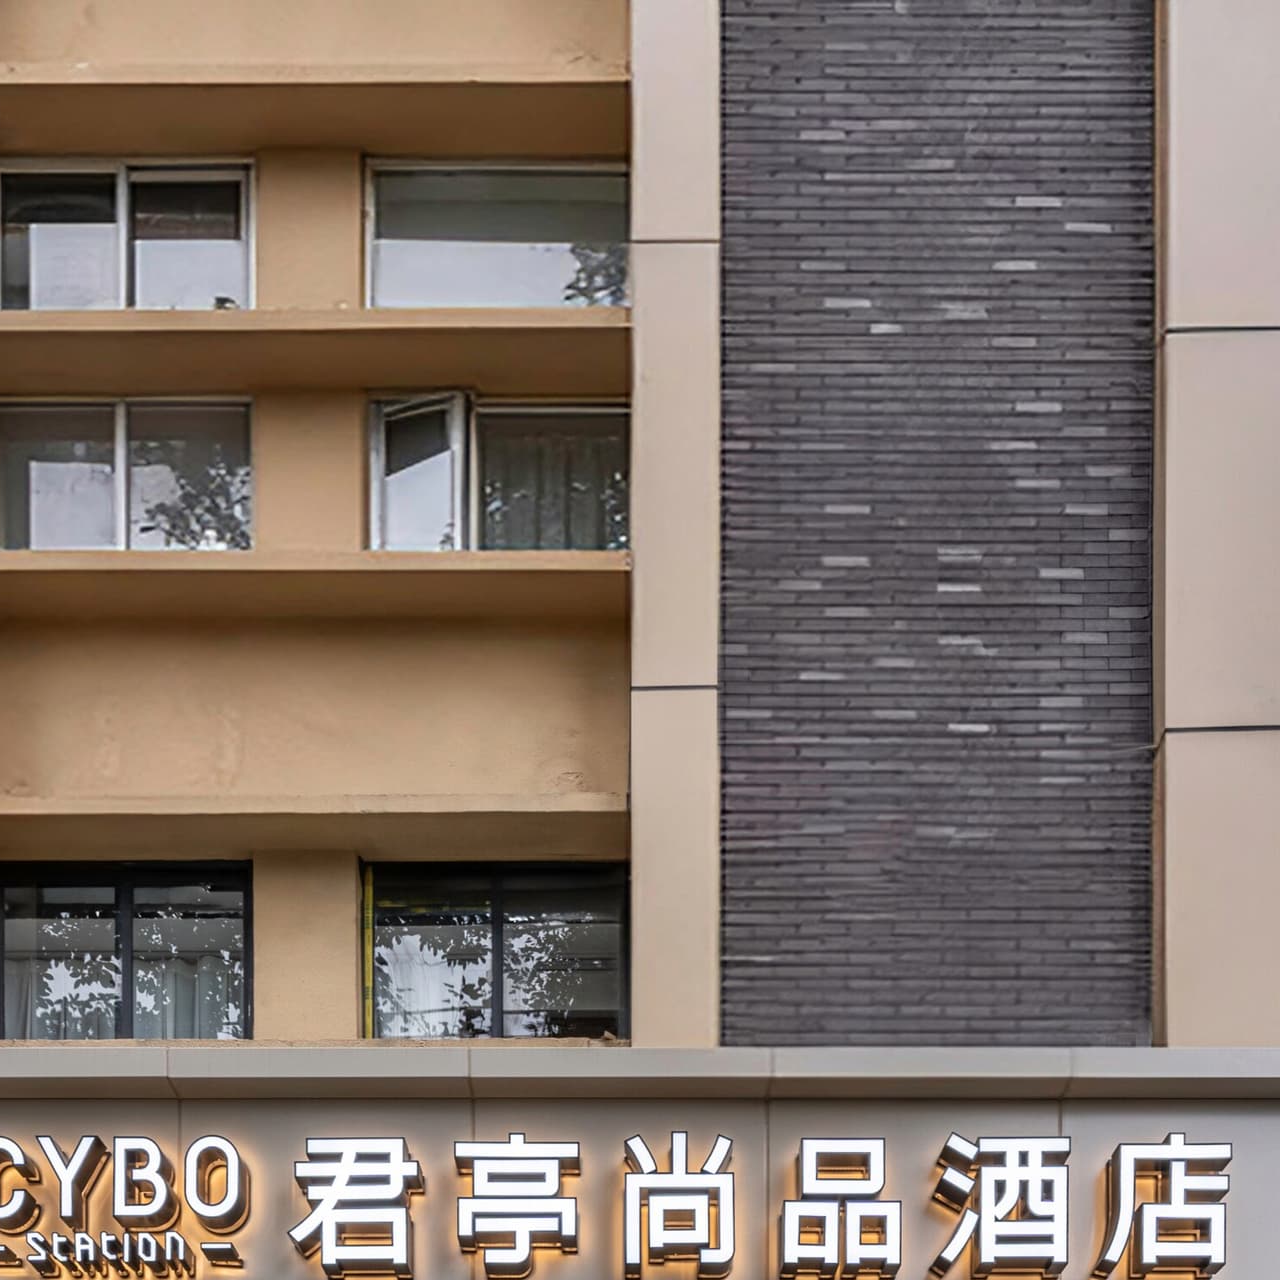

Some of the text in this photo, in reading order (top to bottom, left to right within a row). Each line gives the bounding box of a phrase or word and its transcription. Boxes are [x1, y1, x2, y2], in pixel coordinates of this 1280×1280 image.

[287, 1131, 1232, 1266] 君亭尚品酒店
